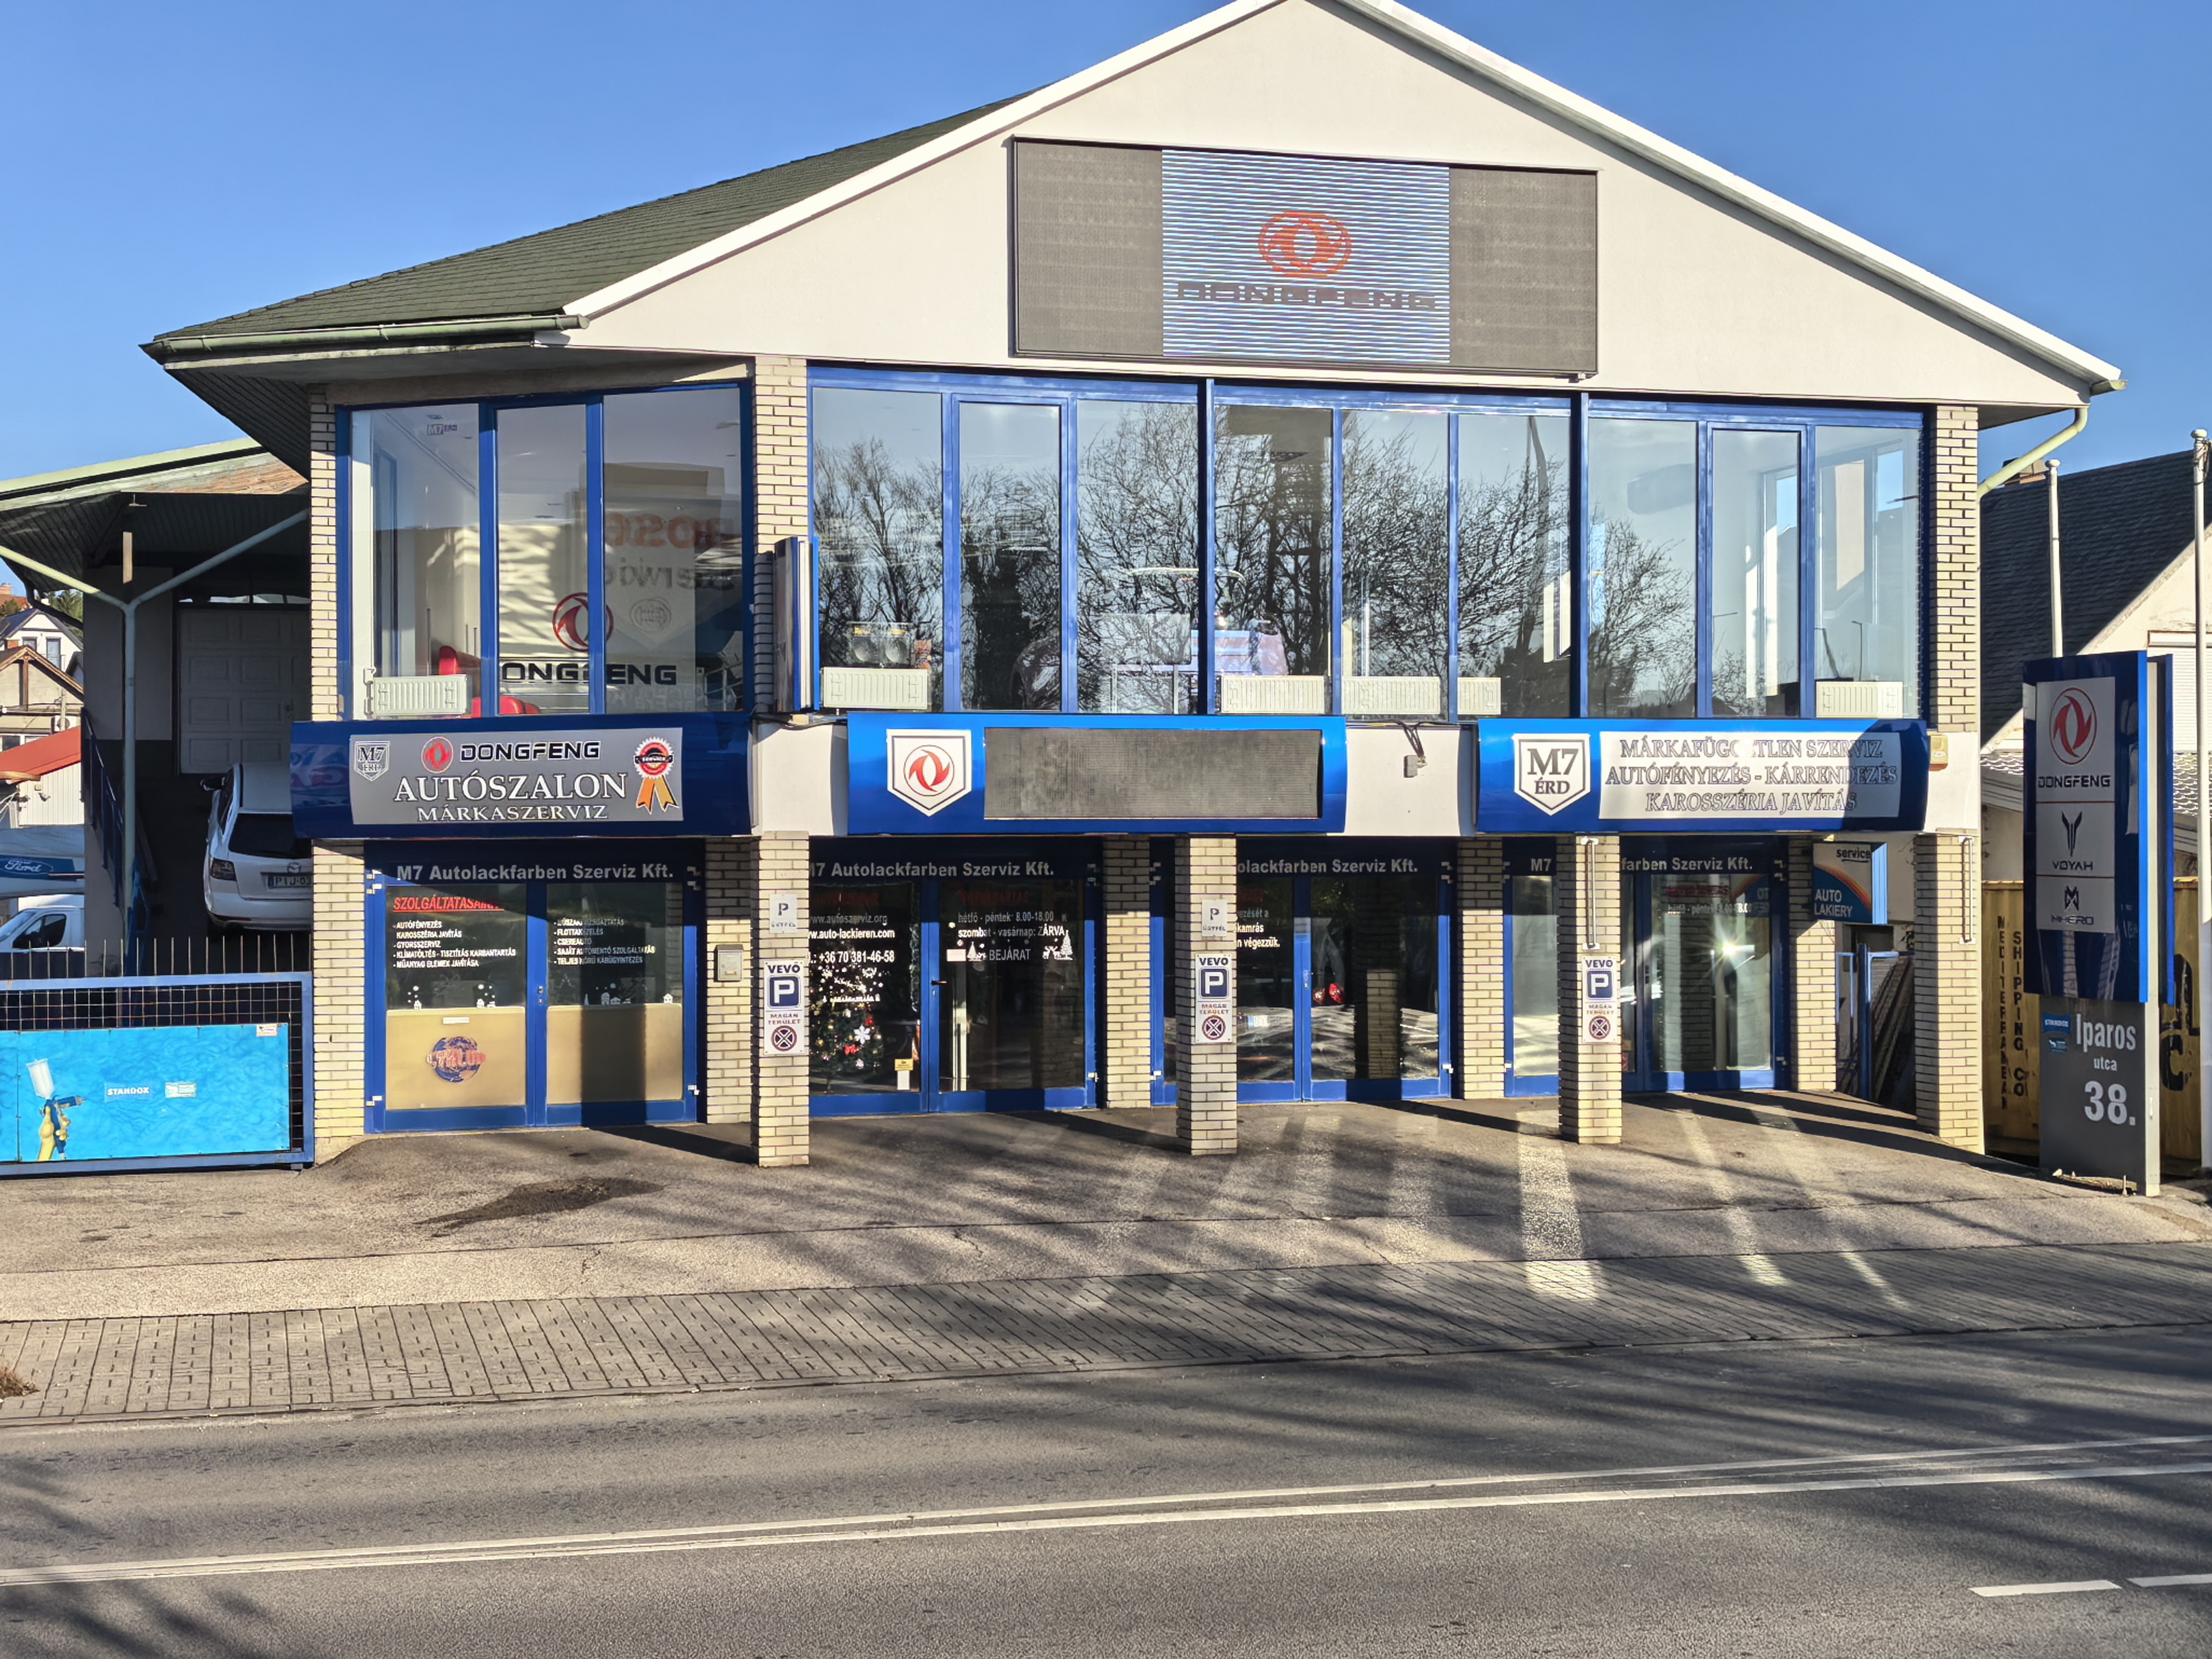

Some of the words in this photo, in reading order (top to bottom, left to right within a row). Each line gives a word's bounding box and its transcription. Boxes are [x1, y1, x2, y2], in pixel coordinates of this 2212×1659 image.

[359, 747, 385, 762] M7
[460, 741, 601, 763] DONGFENG
[1806, 739, 1883, 758] SZERVIZ
[1527, 748, 1579, 775] M7
[1605, 761, 1750, 785] AUTÓFÉNYEZÉS
[1765, 761, 1898, 785] KÁRRENDEZÉS
[394, 770, 627, 801] AUTÓSZALON
[1534, 777, 1570, 794] ÉRD
[2038, 775, 2111, 789] DONGFENG
[1645, 788, 1778, 812] KAROSSZÉRIA
[1779, 788, 1857, 815] JAVÍTÁS
[417, 804, 608, 821] MÁRKASZERVIZ
[1837, 847, 1871, 859] service
[397, 866, 423, 880] M7
[430, 864, 567, 880] Autolackfarben
[572, 864, 636, 879] Szerviz
[642, 864, 673, 878] Kft.
[831, 862, 957, 877] Autolackfarben
[962, 862, 1020, 876] Szerviz
[1026, 861, 1054, 875] Kft.
[1332, 859, 1386, 873] Szerviz
[1391, 859, 1418, 872] Kft.
[1530, 858, 1552, 872] M7
[1672, 857, 1723, 871] Szerviz
[1728, 857, 1753, 871] Kft.
[2052, 860, 2093, 871] VOYAH
[1815, 889, 1842, 902] AUTO
[778, 902, 788, 916] P
[1210, 908, 1219, 921] P
[1813, 903, 1852, 918] LAKIERY
[396, 920, 442, 929] AUTÓFÉNYEZÉS
[958, 927, 990, 938] szombat
[999, 927, 1036, 939] vasárnap:
[1038, 923, 1065, 936] ZÁRVA
[396, 930, 437, 939] KAROSSZÉRIA
[439, 929, 462, 938] JAVÍTÁS
[819, 952, 835, 962] +36
[838, 952, 849, 962] 70
[852, 950, 895, 963] 381-46-58
[989, 947, 1031, 961] BEJÁRAT
[1205, 972, 1224, 994] P
[1590, 974, 1609, 995] P
[774, 980, 794, 1003] P
[2013, 931, 2023, 1052] SHIPPING
[2076, 1013, 2136, 1053] Iparos
[2094, 1056, 2117, 1072] utca
[2013, 1068, 2024, 1097] CO
[107, 1086, 150, 1096] STANDOX
[2084, 1081, 2136, 1126] 38.
